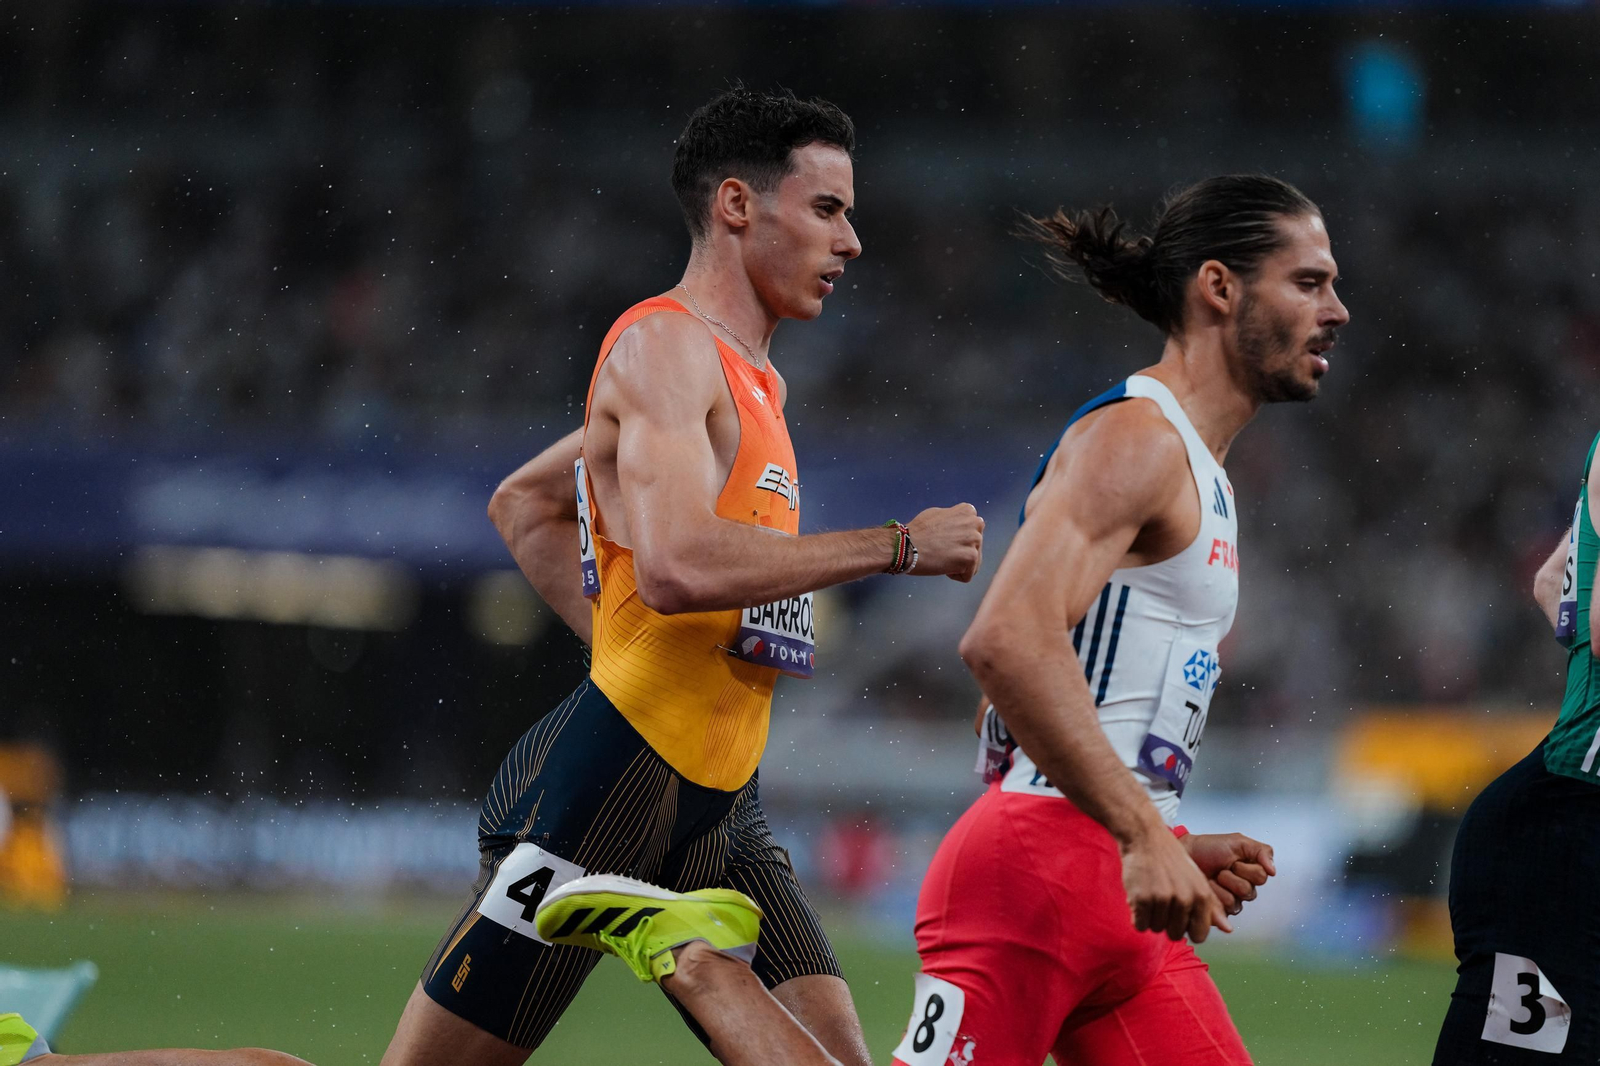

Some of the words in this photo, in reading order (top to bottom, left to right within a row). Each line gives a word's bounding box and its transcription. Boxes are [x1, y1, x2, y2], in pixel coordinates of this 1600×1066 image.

[506, 866, 556, 924] 4
[451, 953, 472, 993] ESP
[912, 993, 945, 1054] 8
[1509, 971, 1546, 1035] 3
